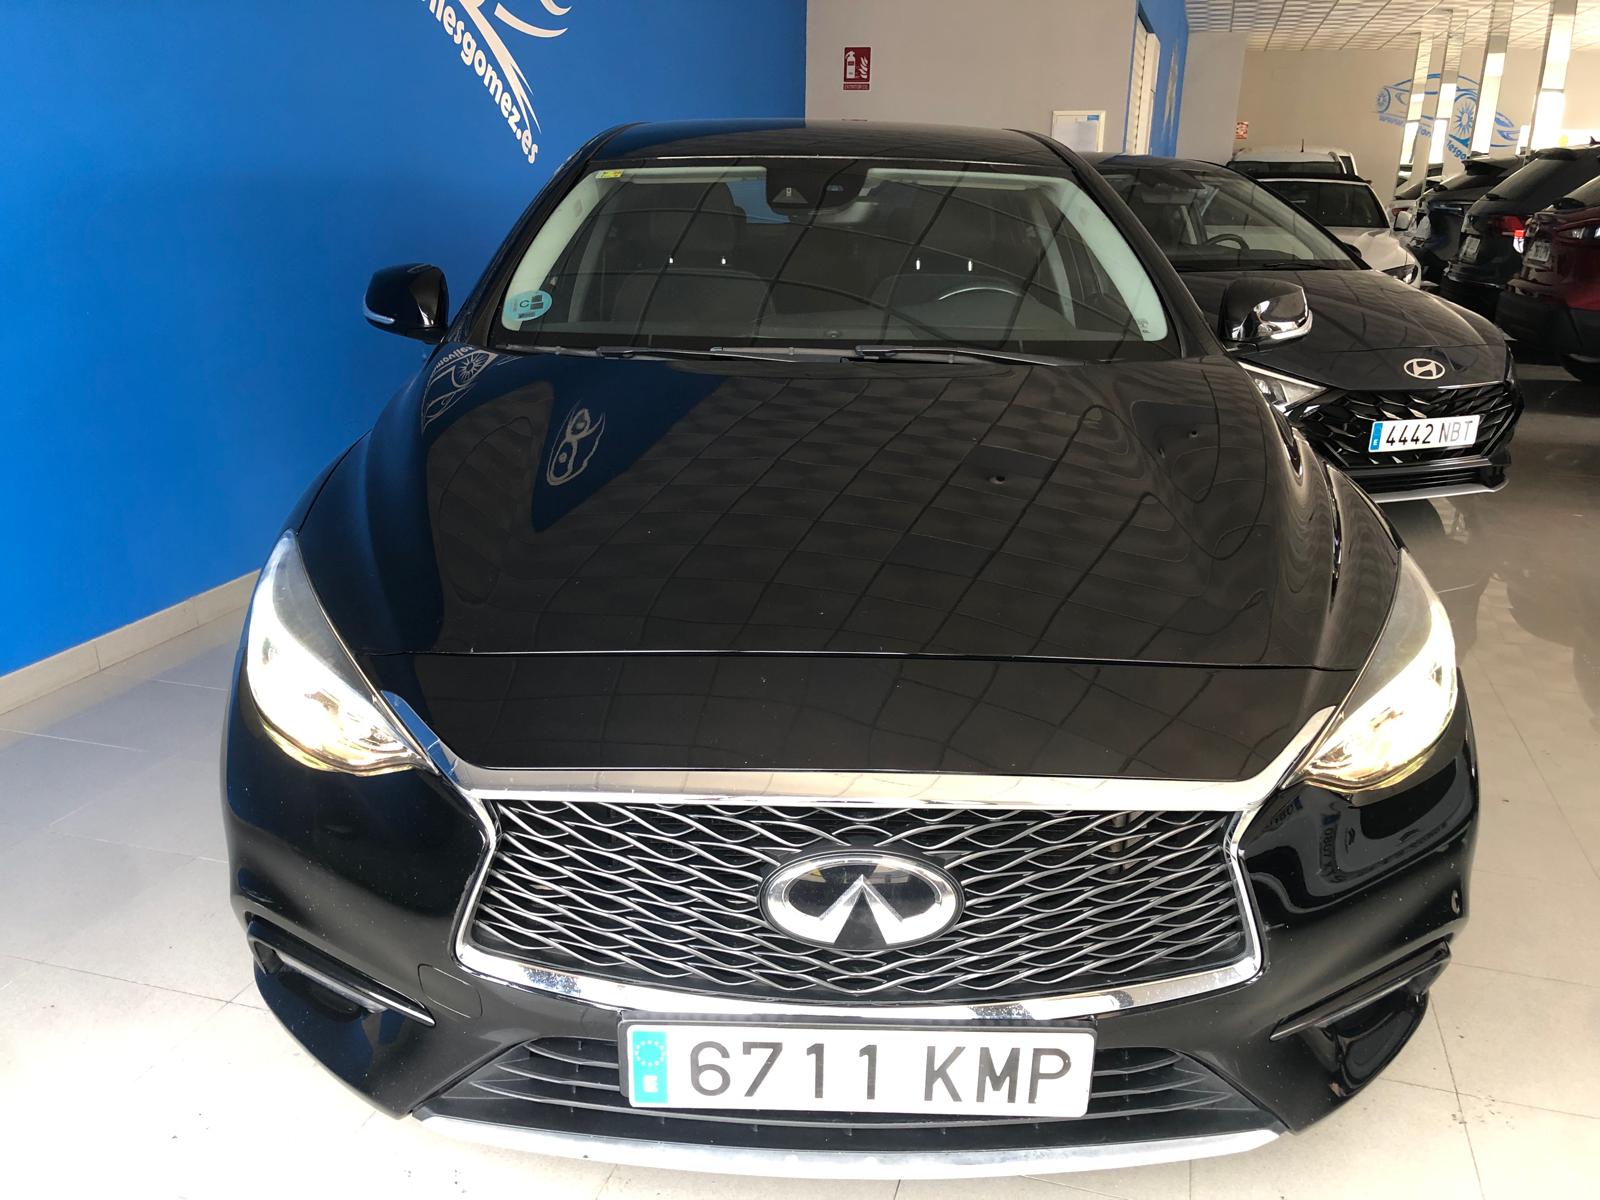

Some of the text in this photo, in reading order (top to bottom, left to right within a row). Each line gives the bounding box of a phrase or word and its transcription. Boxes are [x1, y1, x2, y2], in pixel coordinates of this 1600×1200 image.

[1385, 423, 1434, 446] 4442
[1438, 420, 1473, 444] NBT
[690, 1040, 879, 1100] 6711
[923, 1045, 1072, 1105] KMP
